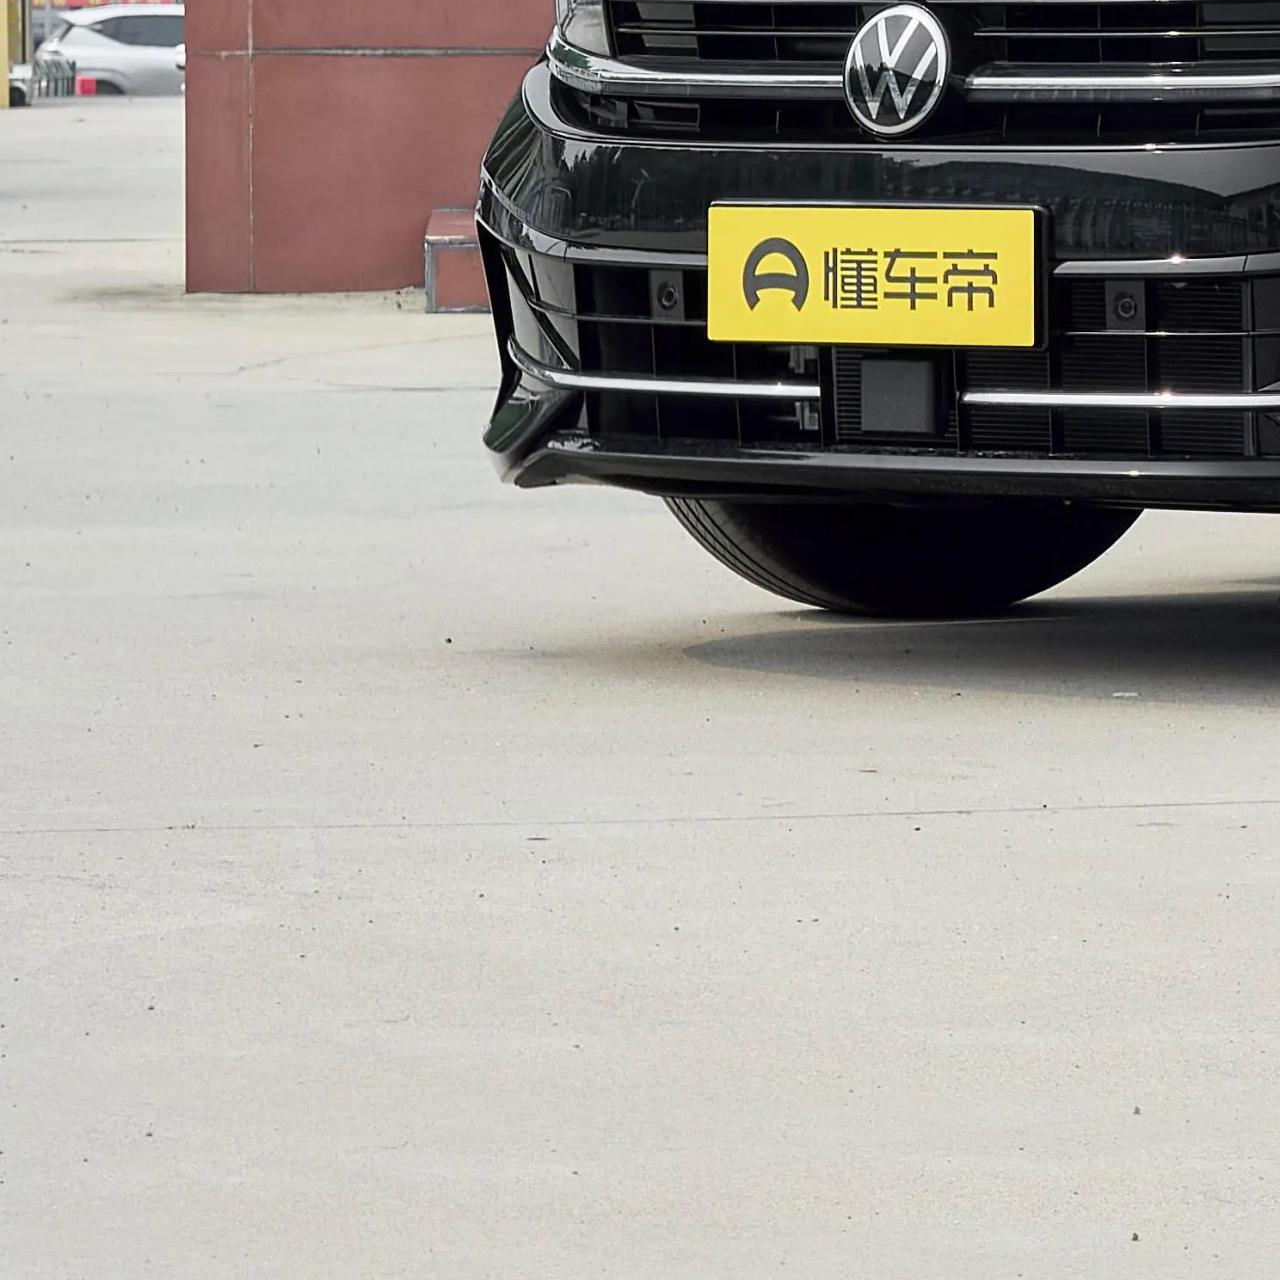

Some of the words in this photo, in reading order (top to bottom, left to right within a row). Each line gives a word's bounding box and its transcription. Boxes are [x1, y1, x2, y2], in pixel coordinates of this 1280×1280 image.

[853, 17, 939, 121] VW
[823, 246, 998, 312] 懂车帝
